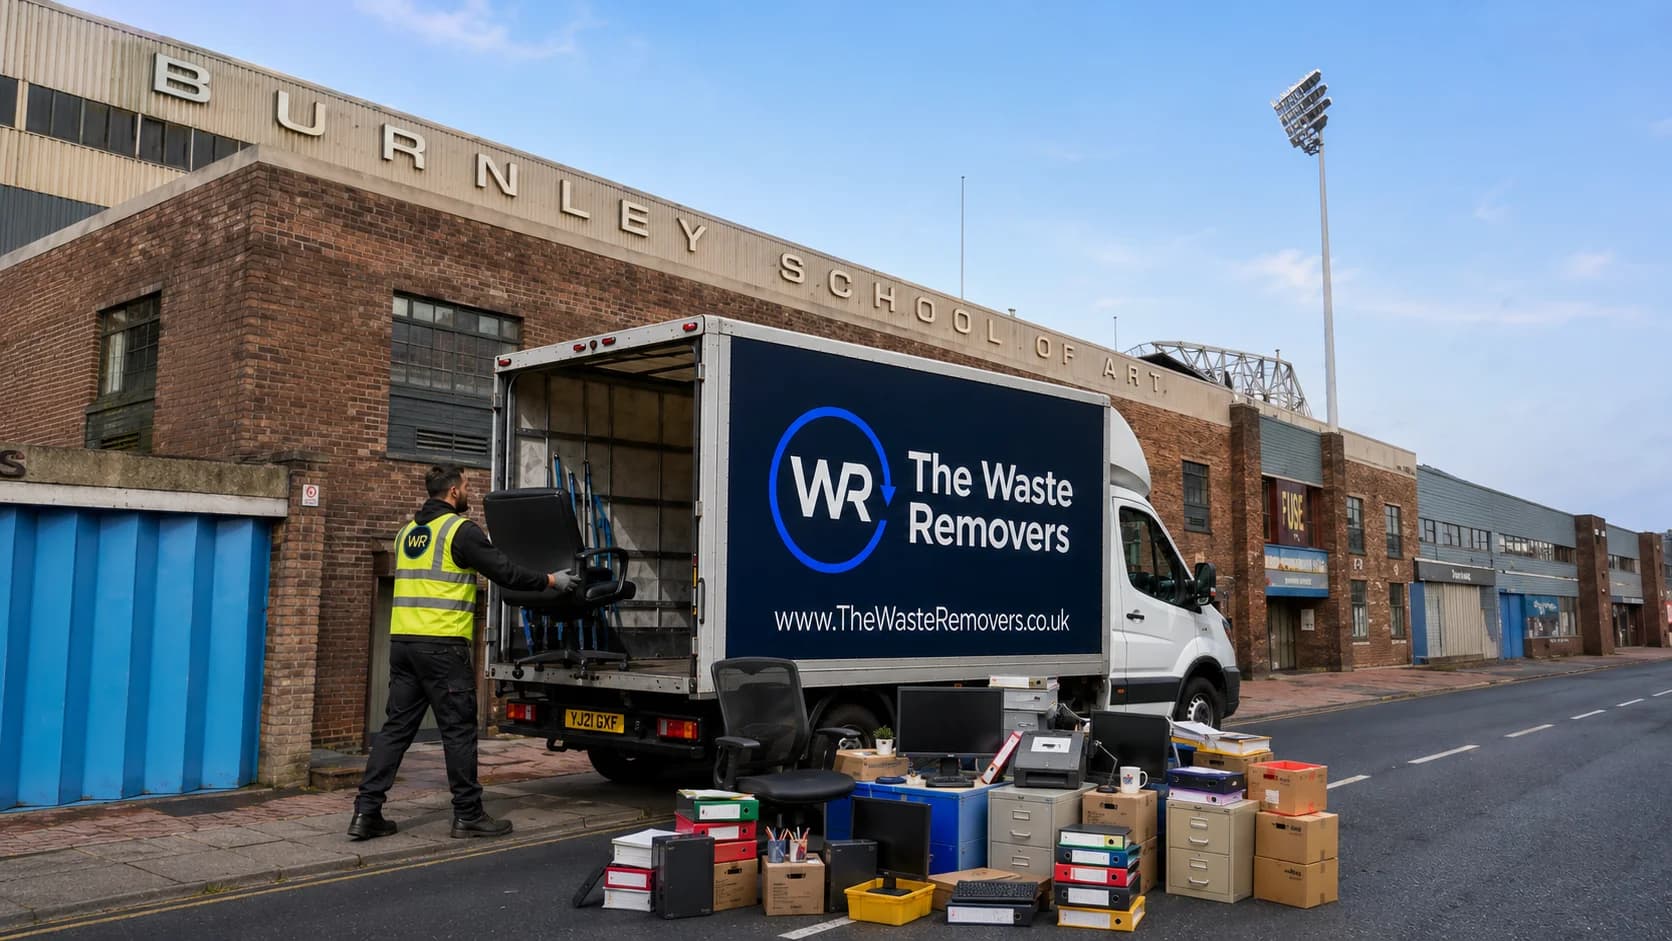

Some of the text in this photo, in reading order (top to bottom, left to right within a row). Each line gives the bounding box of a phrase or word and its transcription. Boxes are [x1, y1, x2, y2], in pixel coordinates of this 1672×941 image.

[153, 52, 706, 252] BURNLEY
[779, 252, 1002, 346] SCHOOL
[1034, 335, 1076, 366] OF
[790, 455, 873, 522] WR
[908, 450, 1074, 508] The Waste
[908, 501, 1071, 554] Removers
[1281, 491, 1305, 532] FUSE
[408, 534, 428, 548] WR
[774, 604, 1071, 632] www.TheWasteRemovers.co.uk
[570, 711, 619, 731] YJ21 GXF
